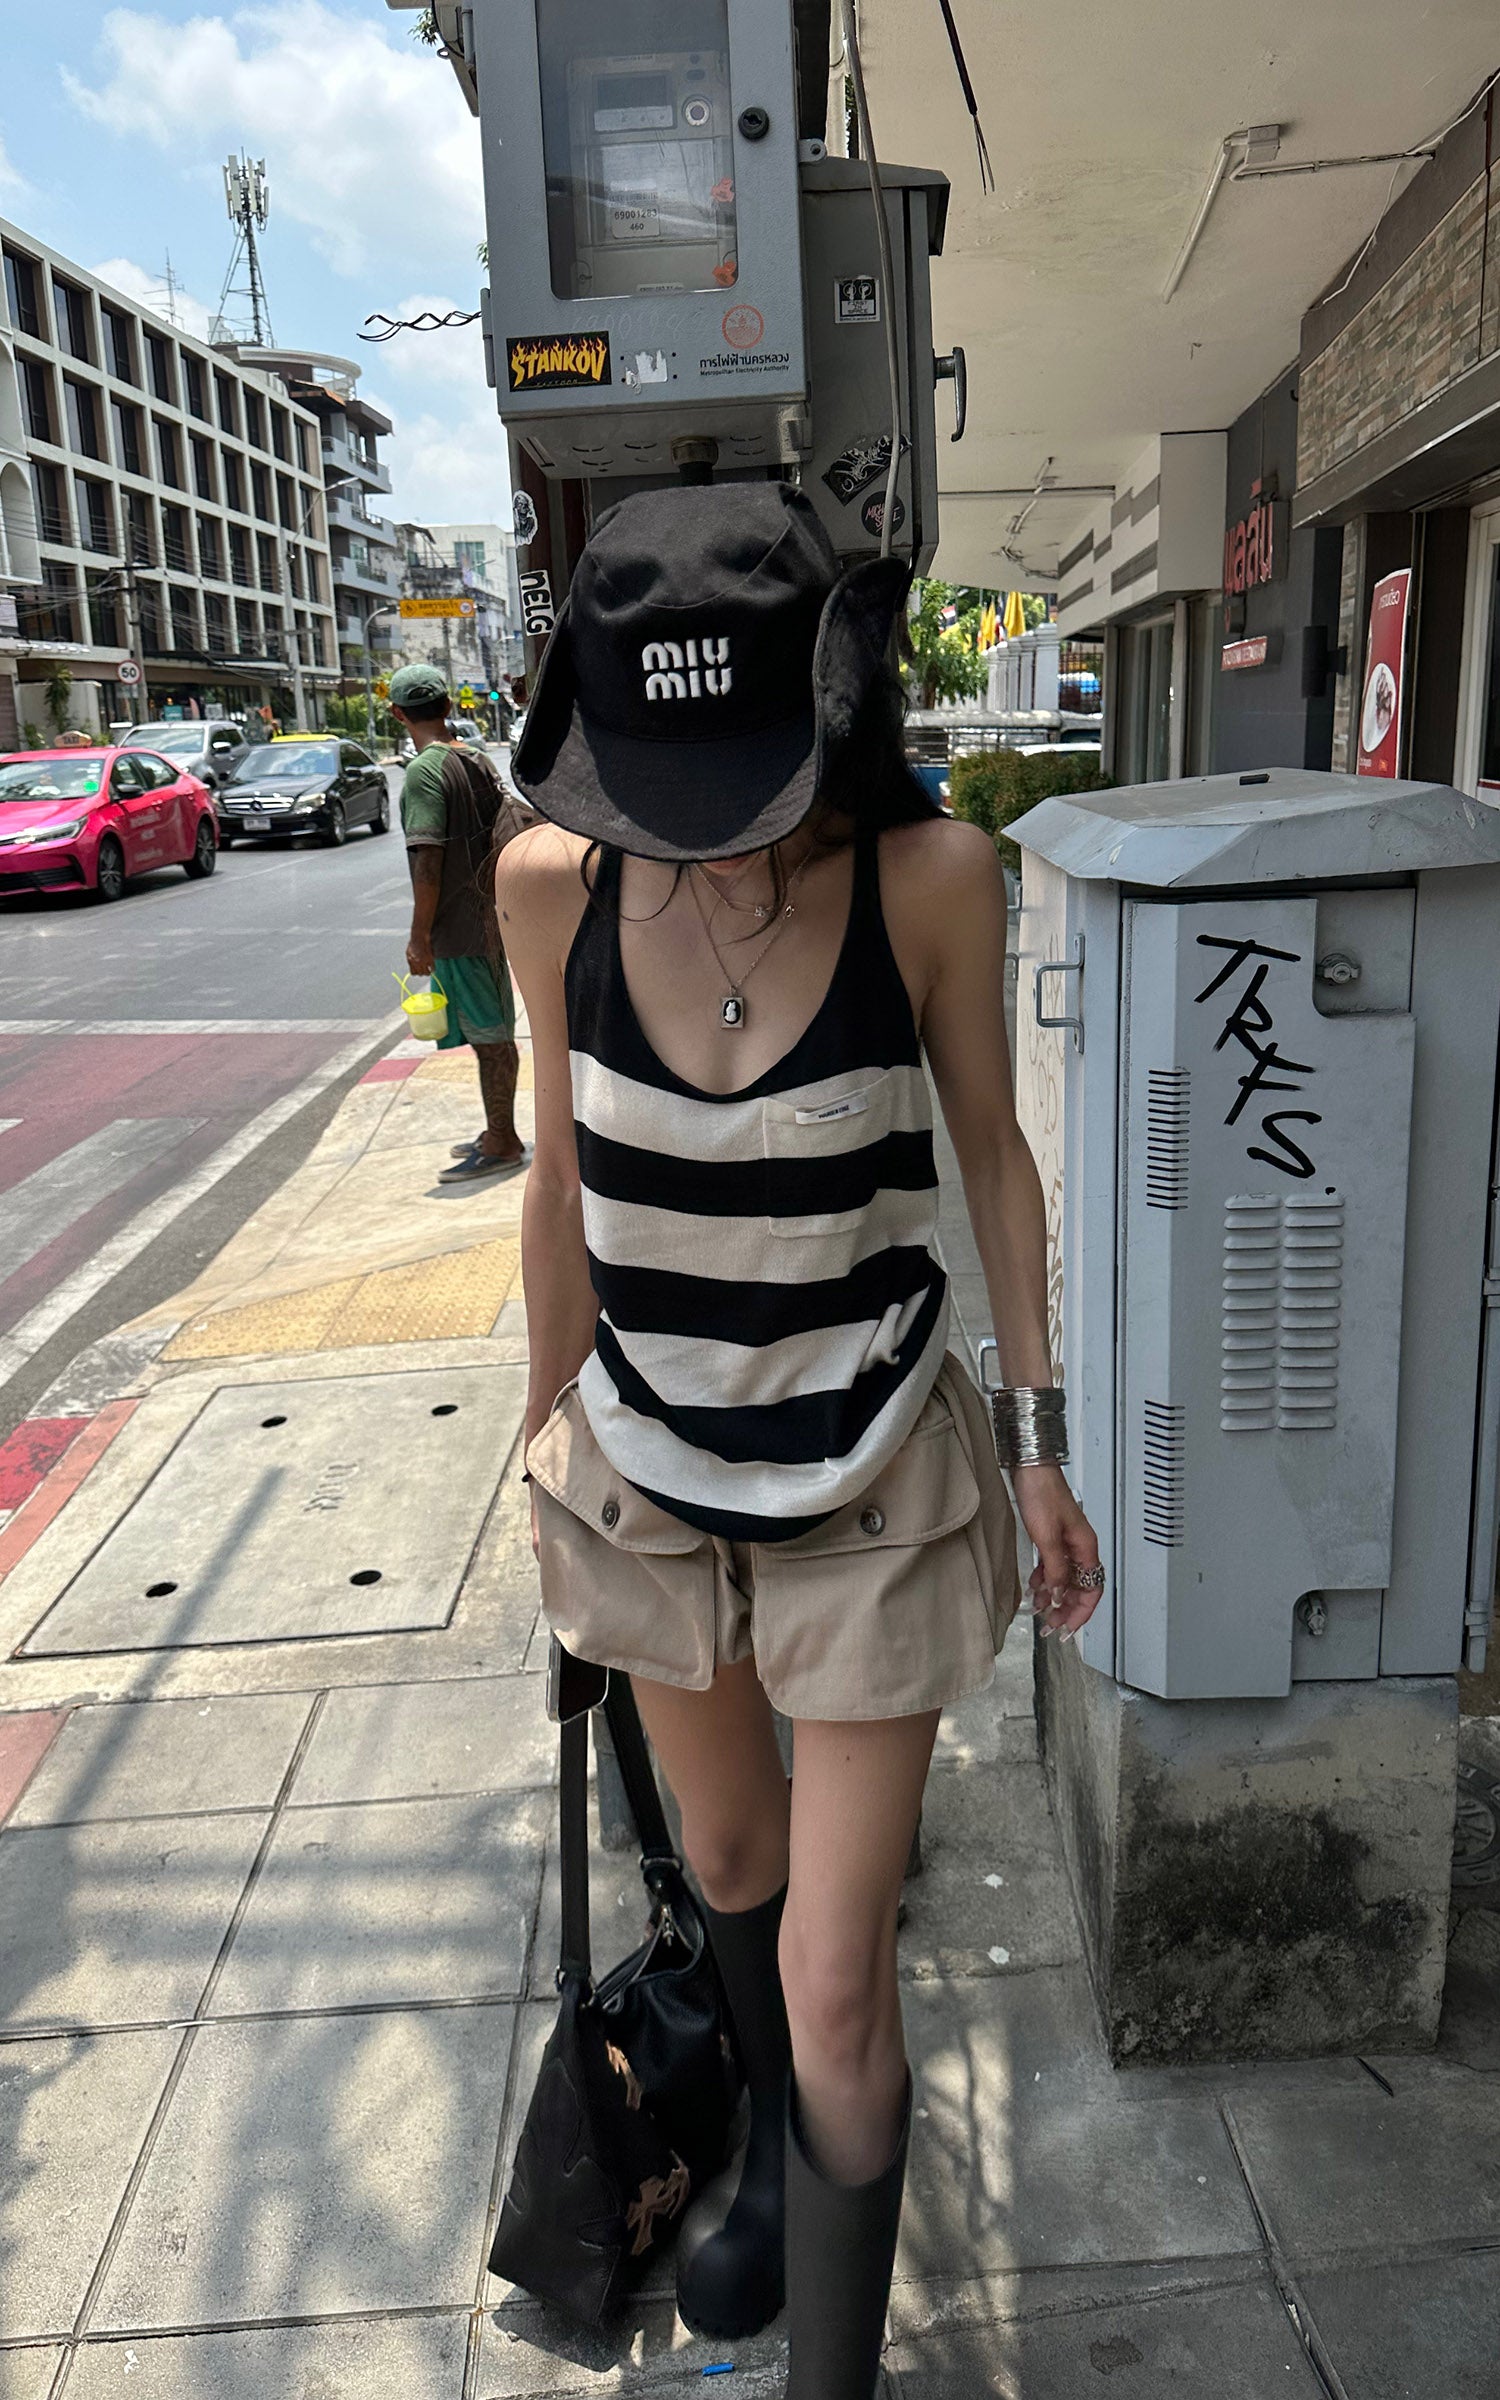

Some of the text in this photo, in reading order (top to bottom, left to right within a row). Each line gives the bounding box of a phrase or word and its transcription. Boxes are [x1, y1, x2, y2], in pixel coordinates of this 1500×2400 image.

[511, 336, 607, 387] STANKOV
[700, 353, 790, 368] การไฟฟ้านครหลวง
[121, 666, 137, 678] 50
